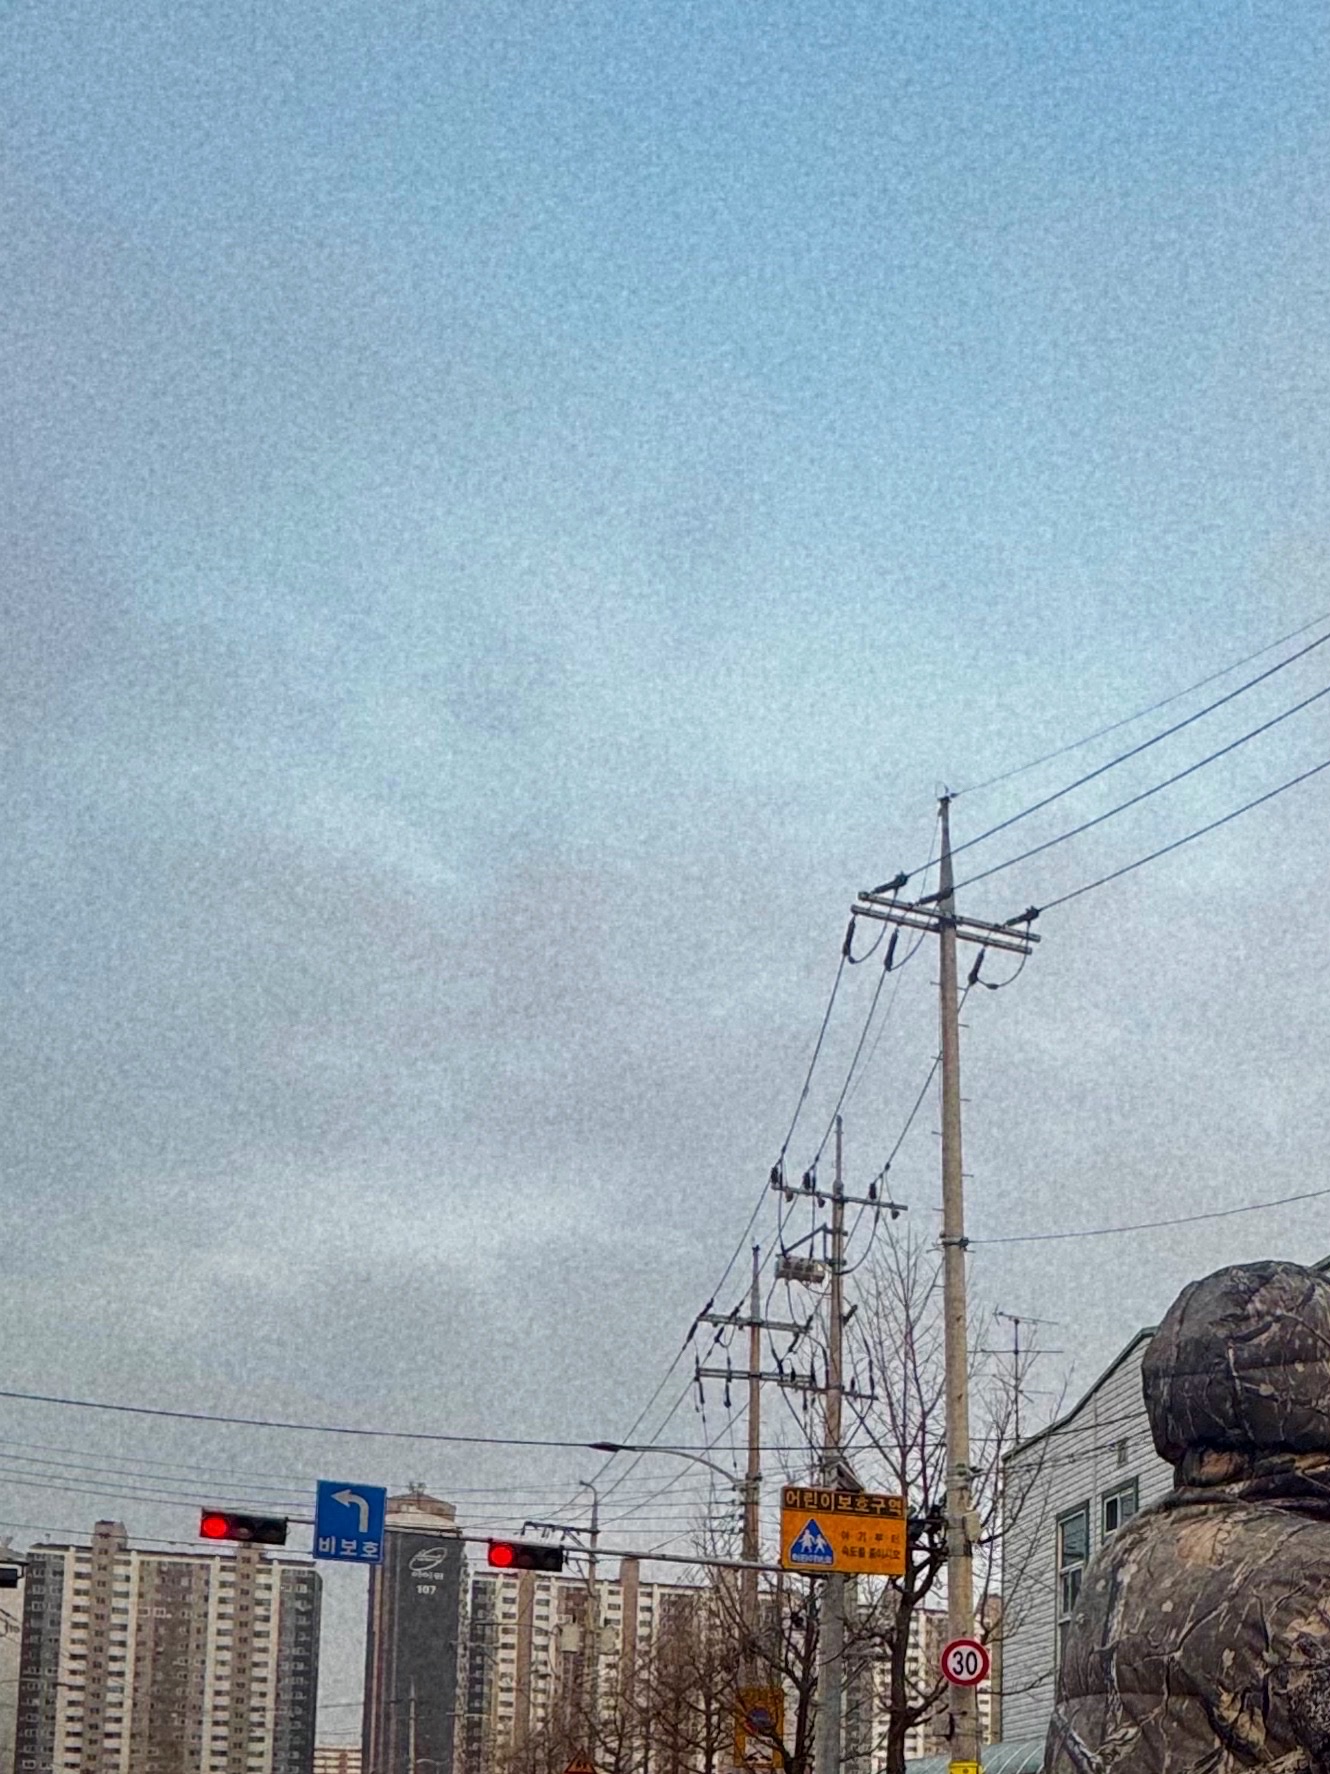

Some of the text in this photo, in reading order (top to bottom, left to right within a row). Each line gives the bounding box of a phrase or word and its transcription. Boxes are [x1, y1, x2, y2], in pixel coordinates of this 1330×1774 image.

[786, 1489, 902, 1516] 어린이보호구역
[318, 1536, 379, 1558] 비보호
[416, 1584, 437, 1596] 107
[952, 1651, 977, 1676] 30
